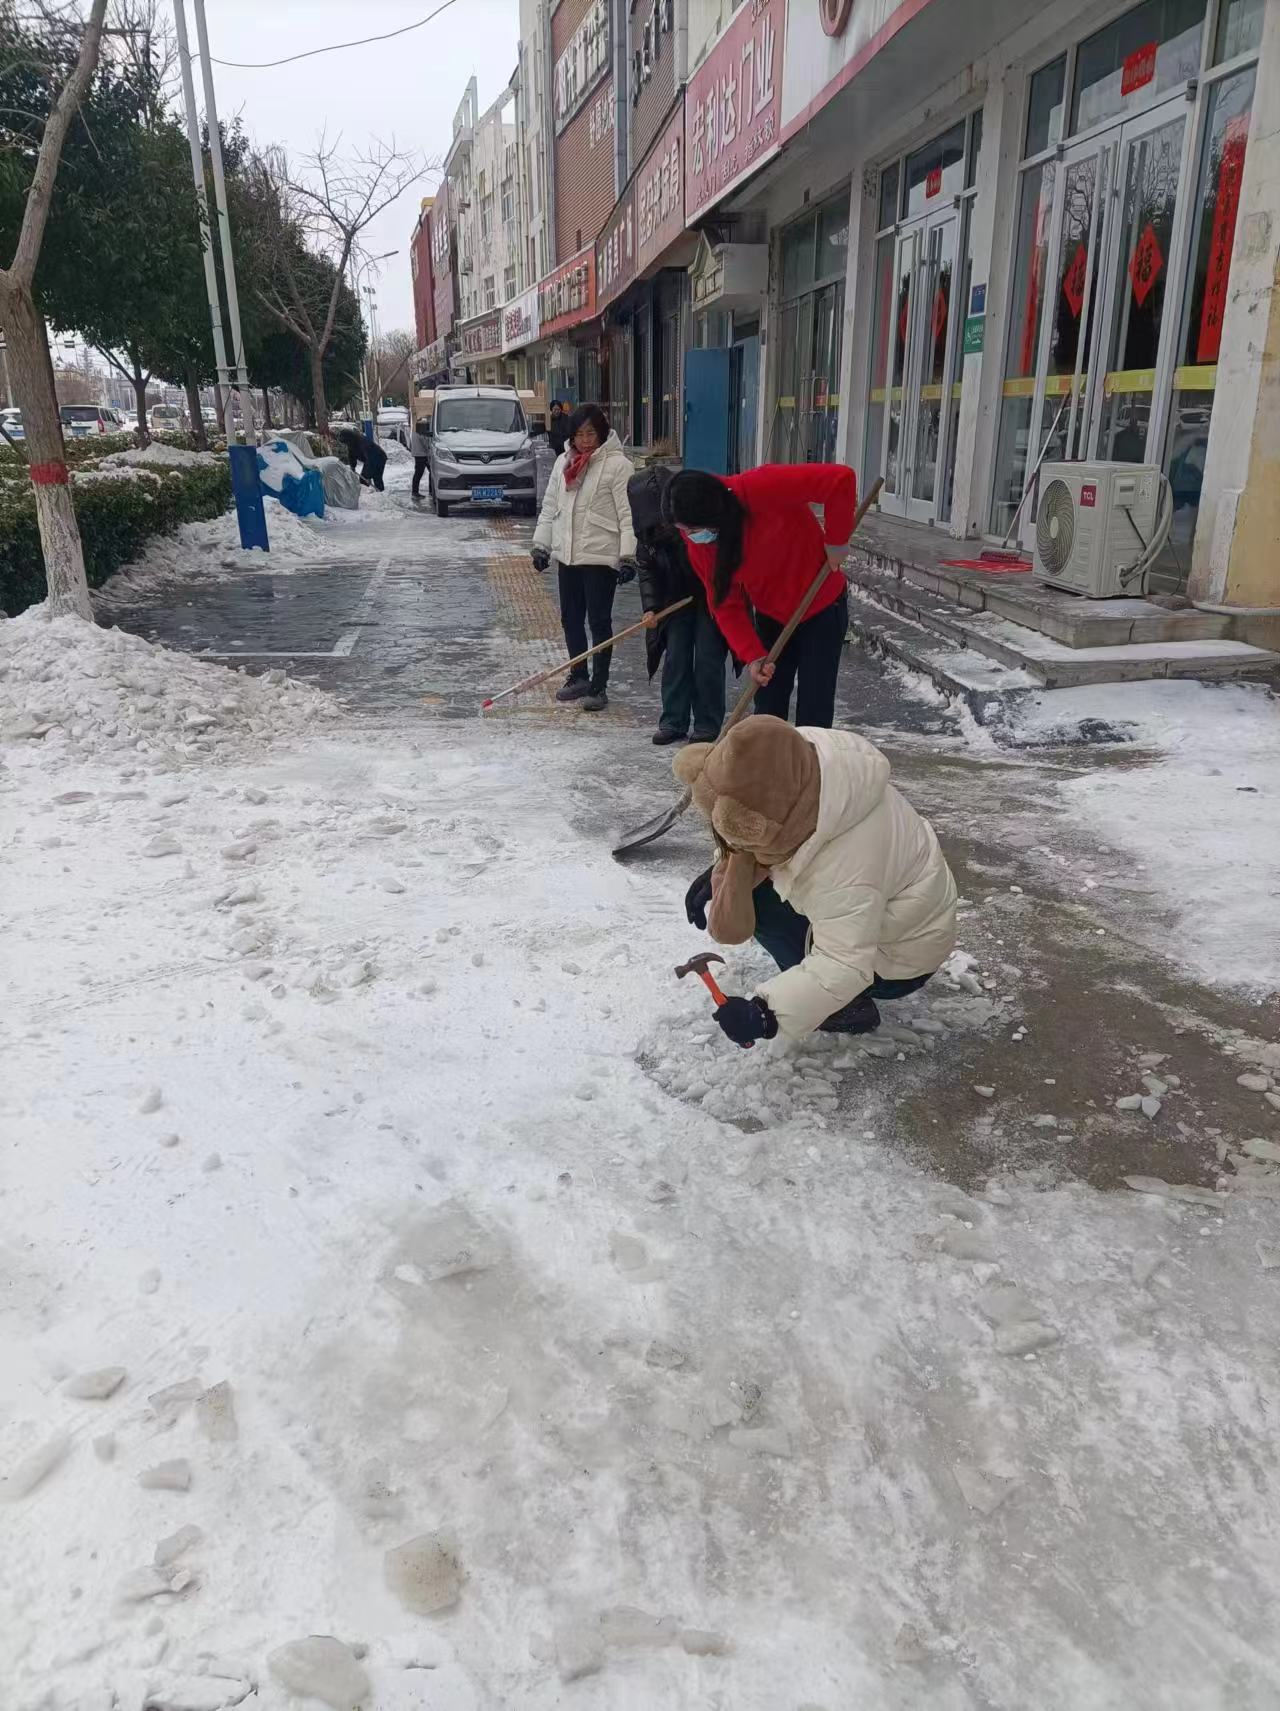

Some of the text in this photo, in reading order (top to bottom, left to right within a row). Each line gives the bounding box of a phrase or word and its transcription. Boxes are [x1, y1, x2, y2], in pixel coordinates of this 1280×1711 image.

[693, 13, 776, 177] 宏利达门业
[1083, 492, 1094, 501] TCL
